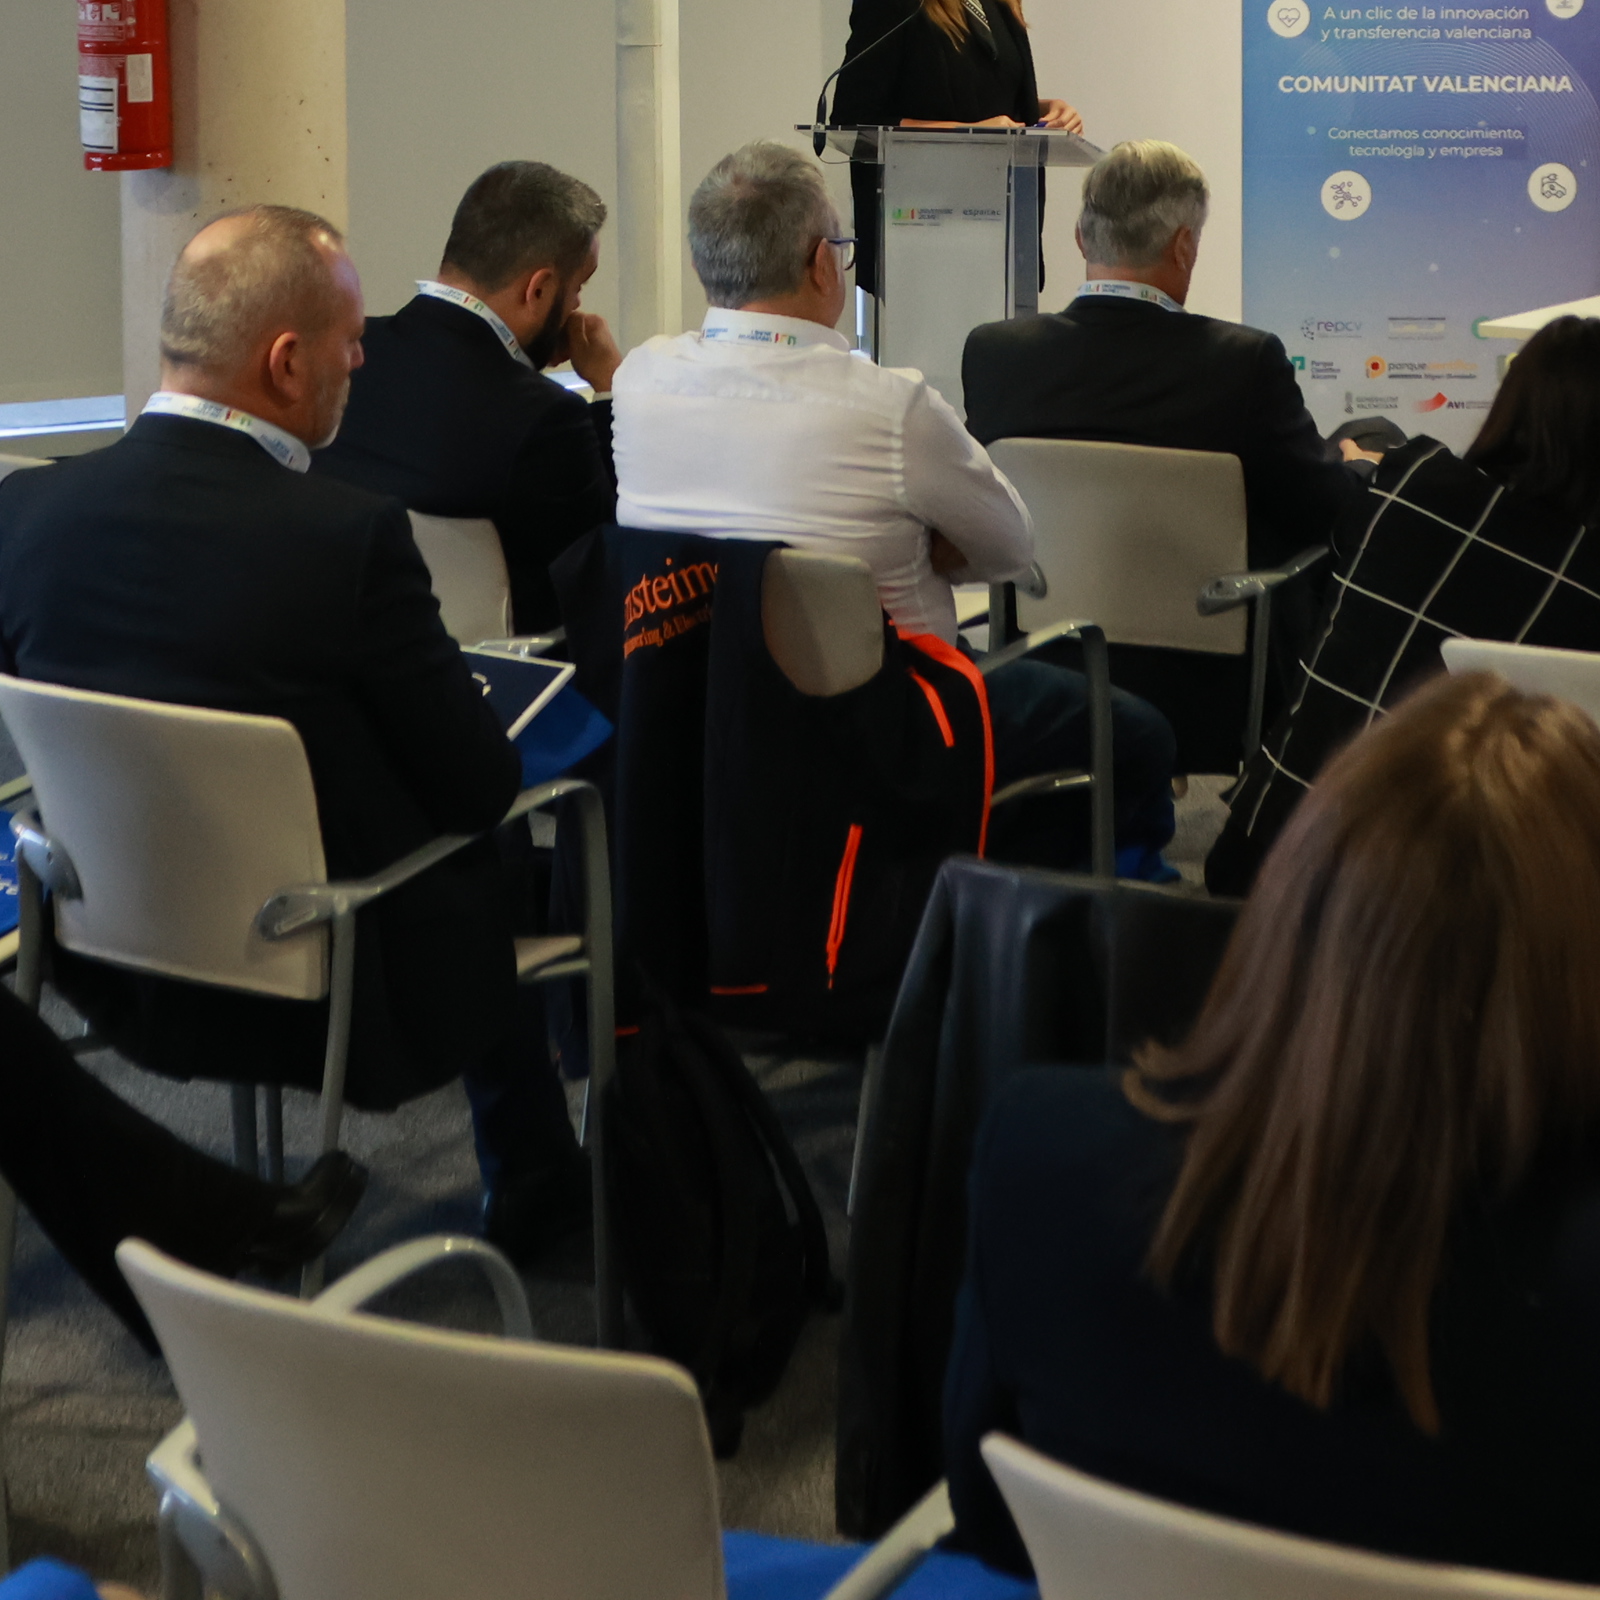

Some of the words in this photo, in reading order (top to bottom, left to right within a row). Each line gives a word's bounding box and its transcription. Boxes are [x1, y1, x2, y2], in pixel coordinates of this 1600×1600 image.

[1323, 7, 1336, 20] A
[1340, 10, 1361, 20] un
[1366, 6, 1393, 20] clic
[1397, 6, 1418, 20] de
[1422, 6, 1436, 20] la
[1440, 6, 1529, 20] innovación
[1321, 28, 1329, 42] y
[1333, 26, 1441, 39] transferencia
[1445, 26, 1532, 39] valenciana
[1279, 75, 1417, 93] COMUNITAT
[1423, 75, 1573, 93] VALENCIANA
[1328, 127, 1419, 140] Conectamos
[1422, 127, 1525, 140] conocimiento,
[1349, 144, 1425, 159] tecnología
[1427, 147, 1436, 159] y
[1440, 147, 1504, 159] empresa
